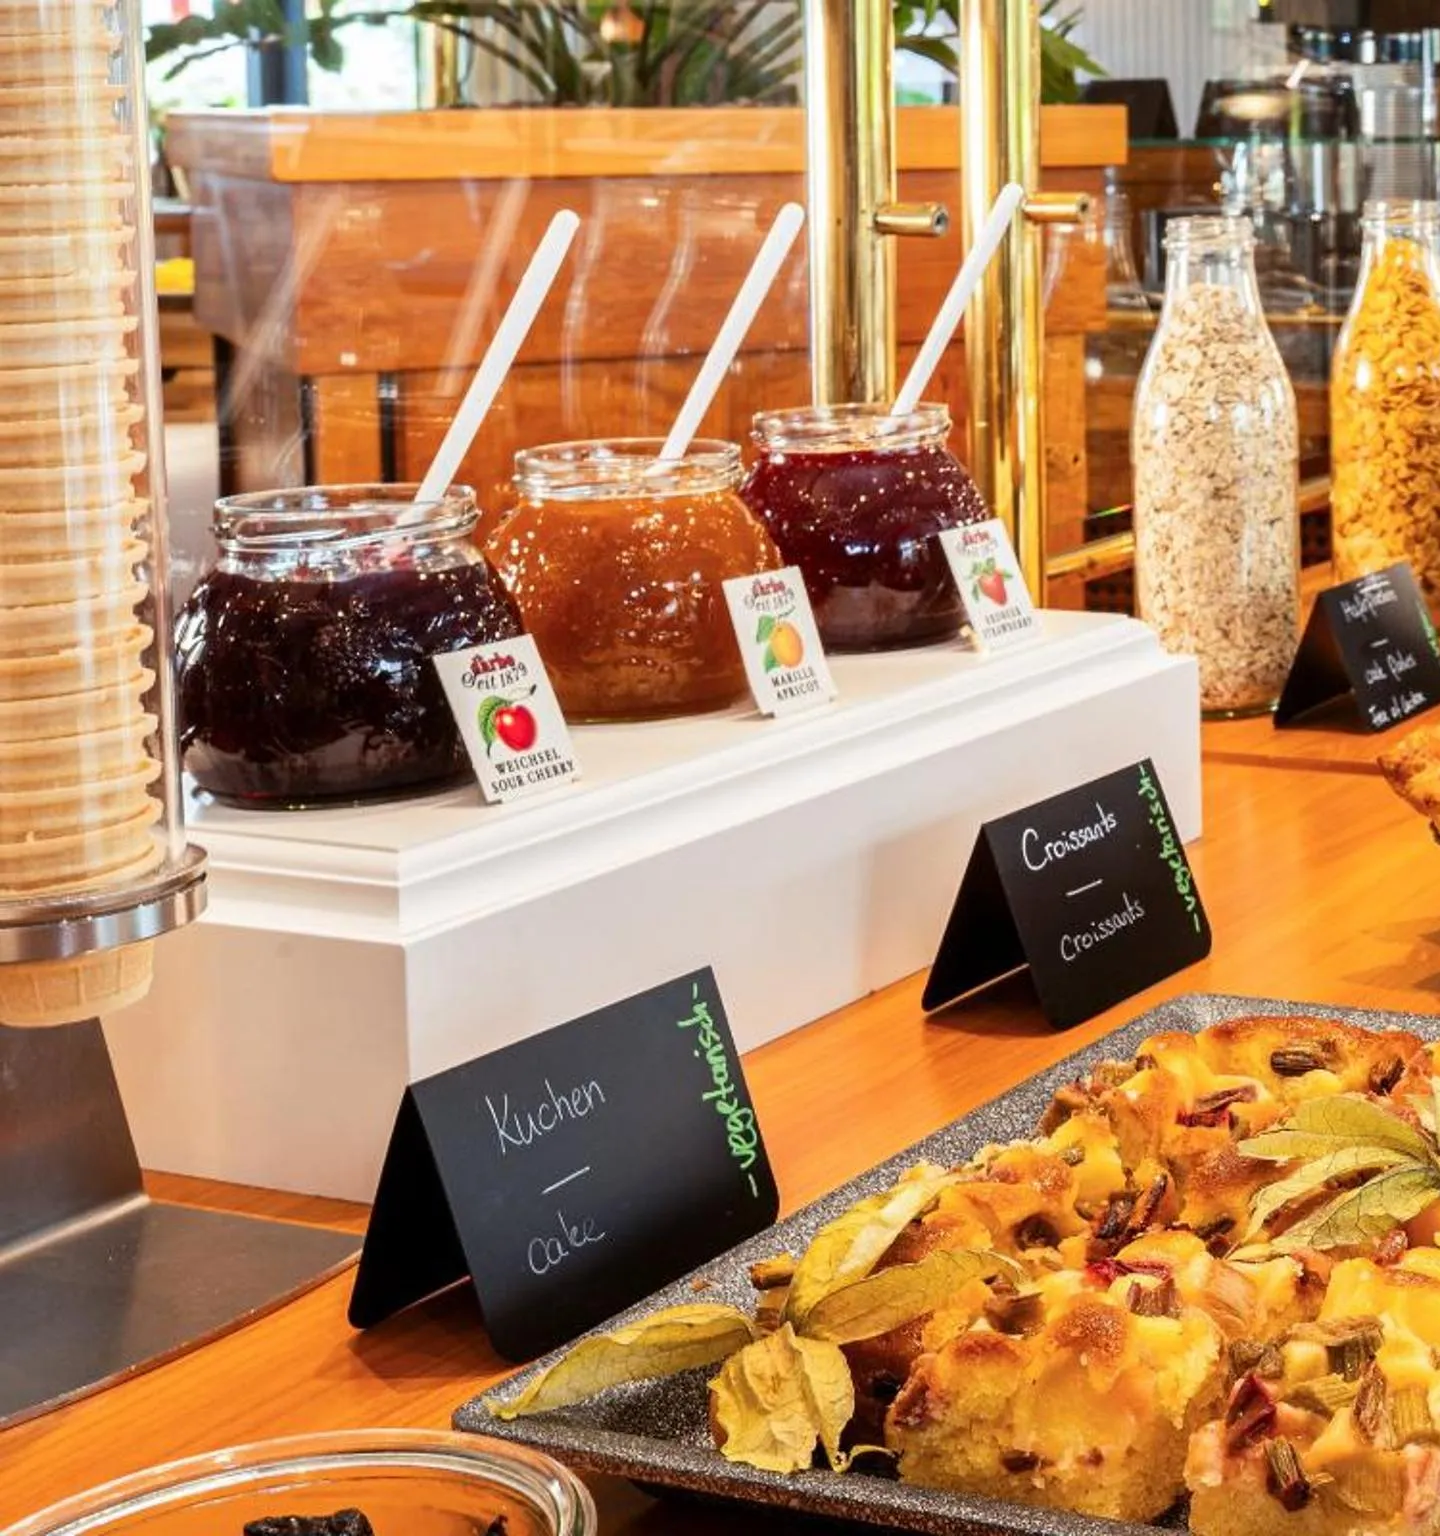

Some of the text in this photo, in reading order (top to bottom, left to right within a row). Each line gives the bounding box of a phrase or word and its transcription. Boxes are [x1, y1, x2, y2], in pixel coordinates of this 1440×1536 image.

[500, 661, 528, 687] 1879
[771, 666, 816, 688] MARILLE
[776, 680, 820, 701] APRICOT
[491, 760, 575, 795] SOUR CHERRY
[495, 748, 561, 776] WEICHSEL
[1021, 801, 1119, 871] Croissants
[1060, 892, 1146, 962] Croissants
[484, 1078, 606, 1155] Kuchen
